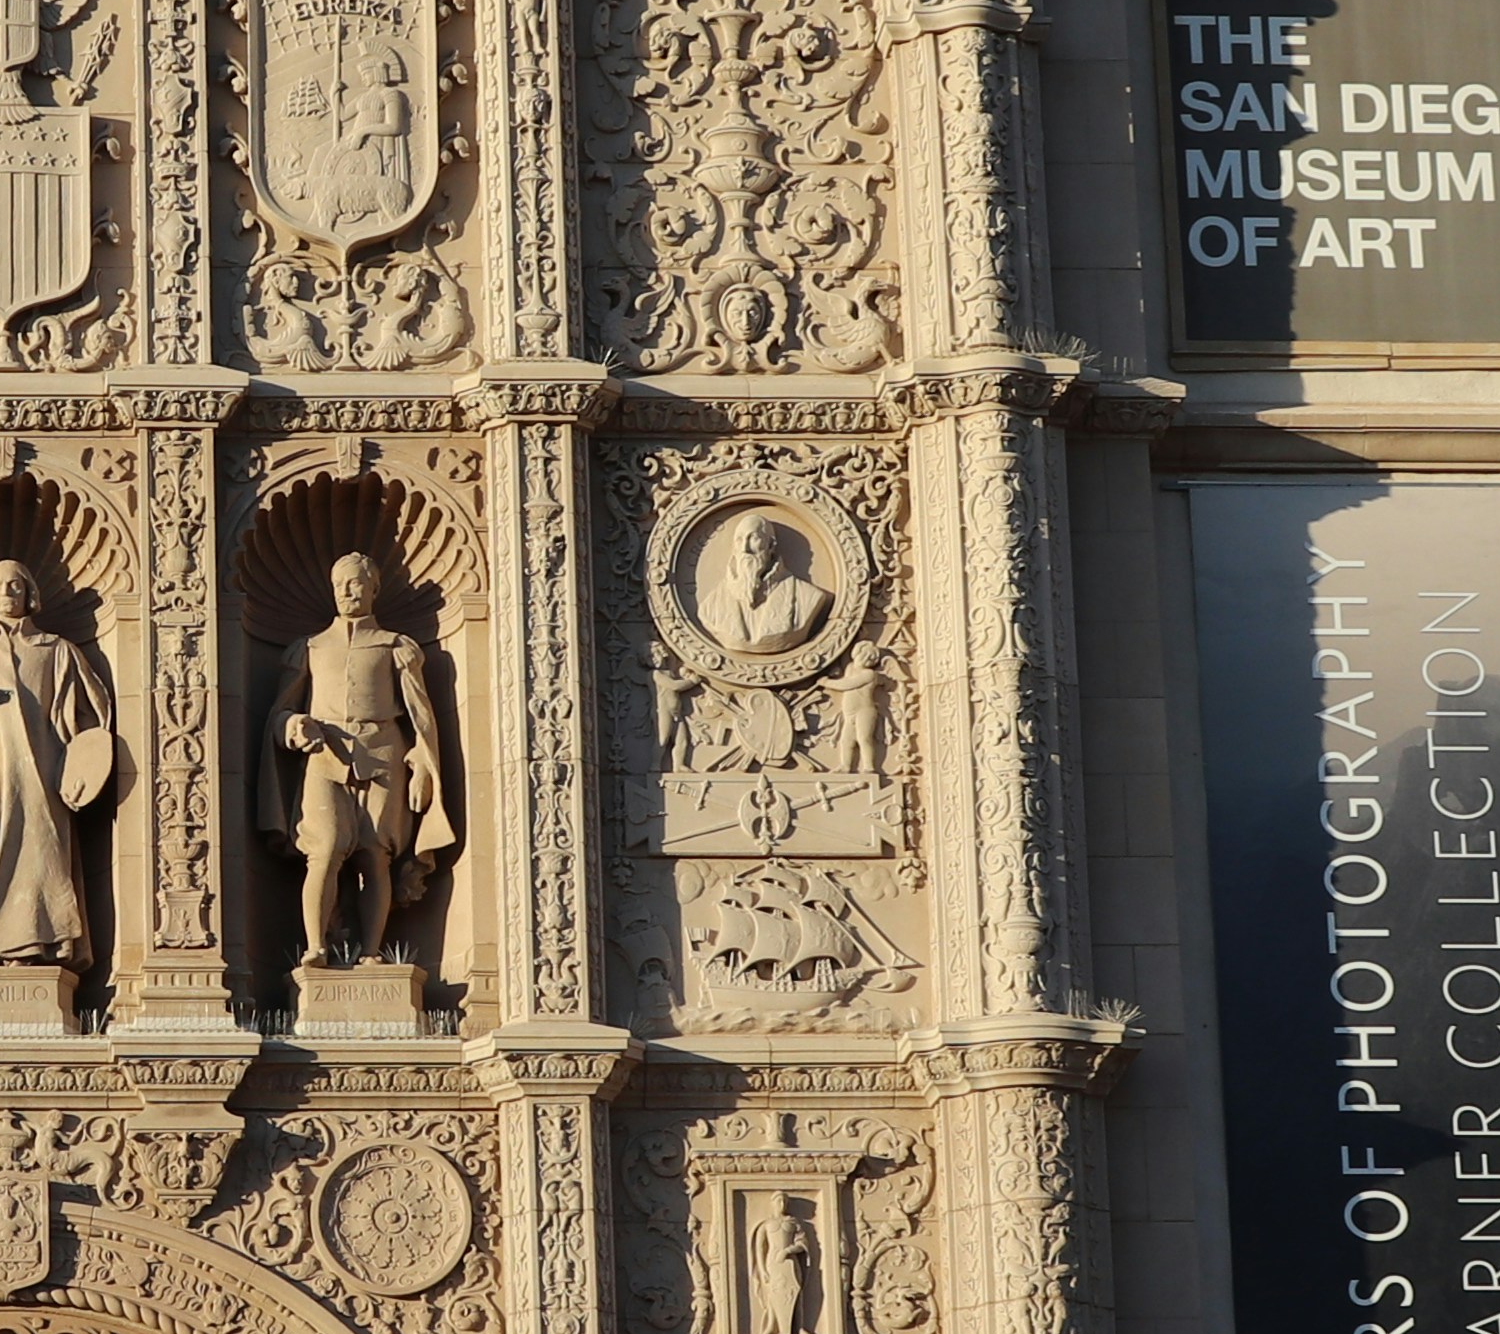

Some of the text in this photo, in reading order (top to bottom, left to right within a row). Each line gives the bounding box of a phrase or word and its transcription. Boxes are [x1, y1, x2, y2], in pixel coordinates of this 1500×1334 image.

[1173, 15, 1311, 66] THE
[1179, 80, 1319, 134] SAN
[1184, 149, 1496, 202] MUSEUM
[1187, 215, 1437, 269] OF ART
[1304, 541, 1402, 1113] PHOTOGRAPHY
[314, 984, 402, 1002] ZURBARAN
[1341, 1145, 1409, 1242] OF
